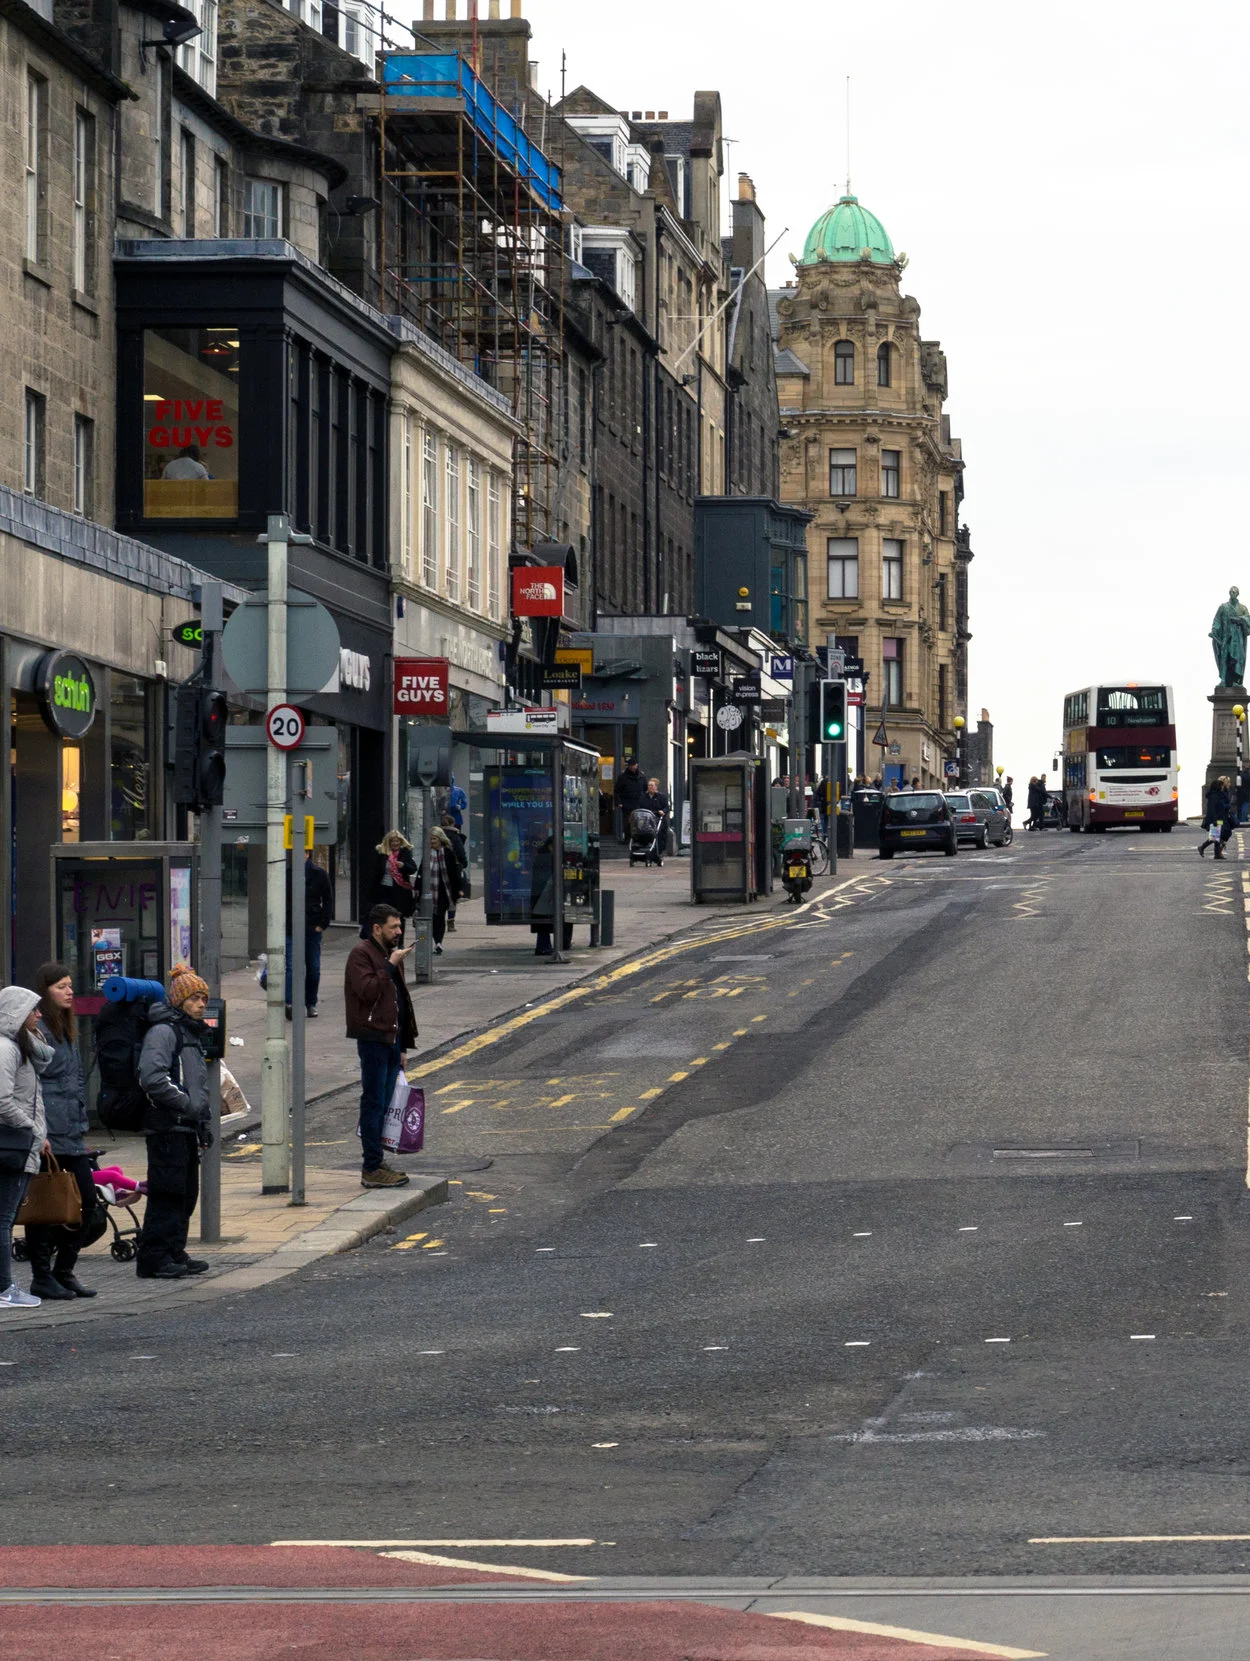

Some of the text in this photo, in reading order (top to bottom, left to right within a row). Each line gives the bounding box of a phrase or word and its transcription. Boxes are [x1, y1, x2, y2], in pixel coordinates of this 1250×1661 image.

[155, 399, 224, 421] FIVE
[149, 426, 233, 448] GUYS
[696, 653, 718, 661] black
[543, 669, 578, 679] Loake
[696, 665, 718, 673] lizars
[402, 676, 440, 688] FIVE
[54, 670, 90, 713] schuh
[397, 690, 445, 702] GUYS
[1107, 716, 1117, 725] 10
[272, 718, 299, 737] 20
[97, 952, 121, 961] GBX
